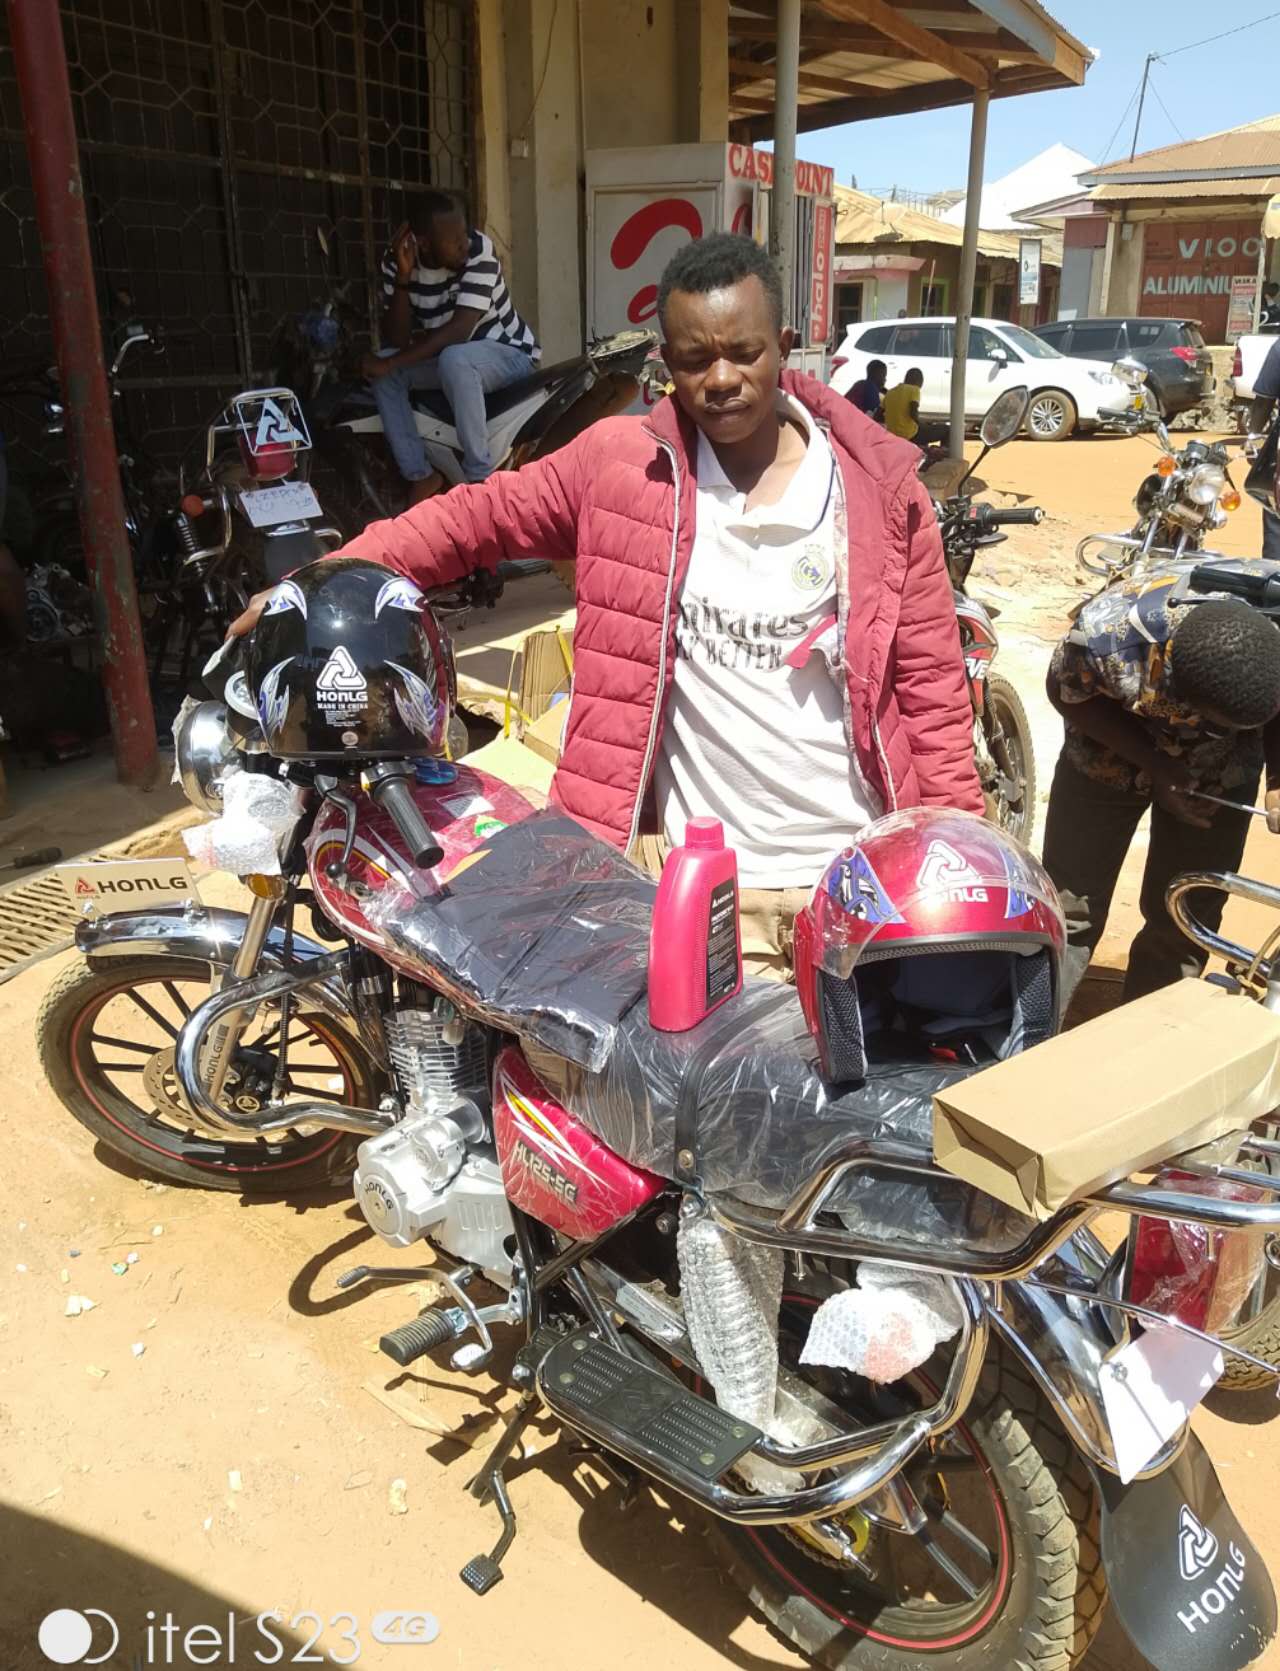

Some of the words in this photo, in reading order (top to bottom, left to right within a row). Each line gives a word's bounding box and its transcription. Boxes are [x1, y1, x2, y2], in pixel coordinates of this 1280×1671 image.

[795, 160, 833, 197] OINT
[1143, 275, 1234, 295] ALUMINIU
[316, 690, 369, 702] HONLG
[337, 702, 346, 710] IN
[347, 702, 369, 711] CHINA
[97, 876, 188, 894] HONLG
[1177, 1541, 1245, 1633] HONLG
